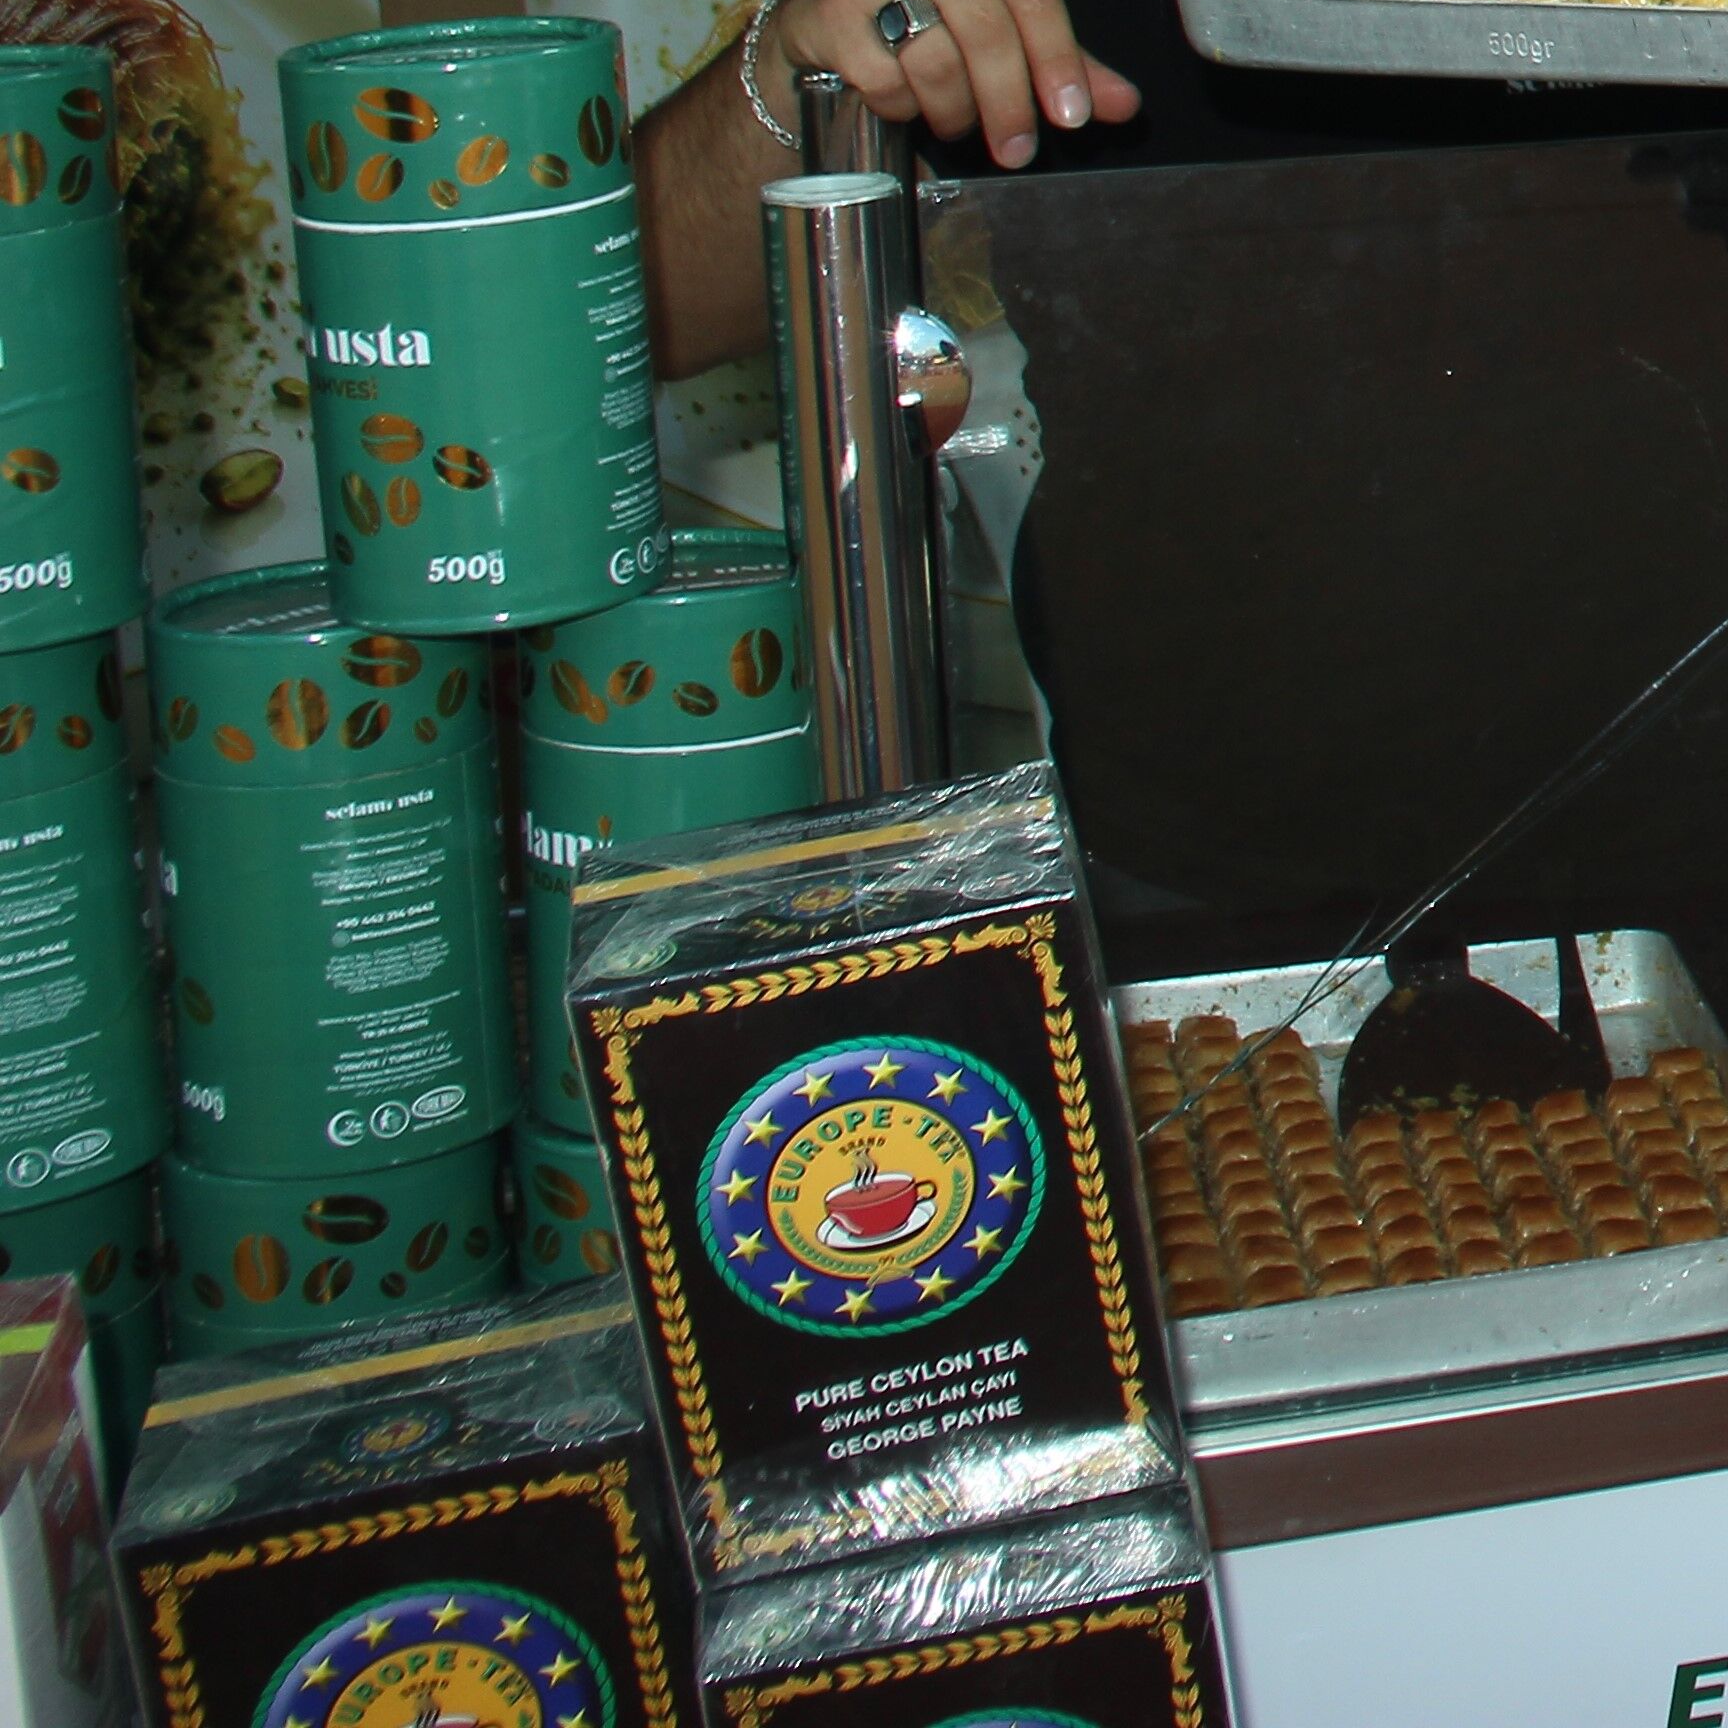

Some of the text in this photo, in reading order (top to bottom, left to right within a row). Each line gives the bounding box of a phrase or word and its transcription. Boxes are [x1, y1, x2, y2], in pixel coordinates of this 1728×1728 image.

[1488, 31, 1555, 64] 500gr
[325, 322, 432, 367] usta
[0, 558, 73, 593] 500g
[428, 554, 508, 585] 500g
[397, 788, 436, 809] usta
[771, 1106, 893, 1203] EUROPE
[838, 1135, 887, 1157] BRAND
[795, 1337, 1030, 1414] PURE CEYLON TEA
[820, 1369, 1017, 1434] SİYAH CEYLAN ÇAYI
[827, 1395, 1024, 1461] GEORGE PAYNE
